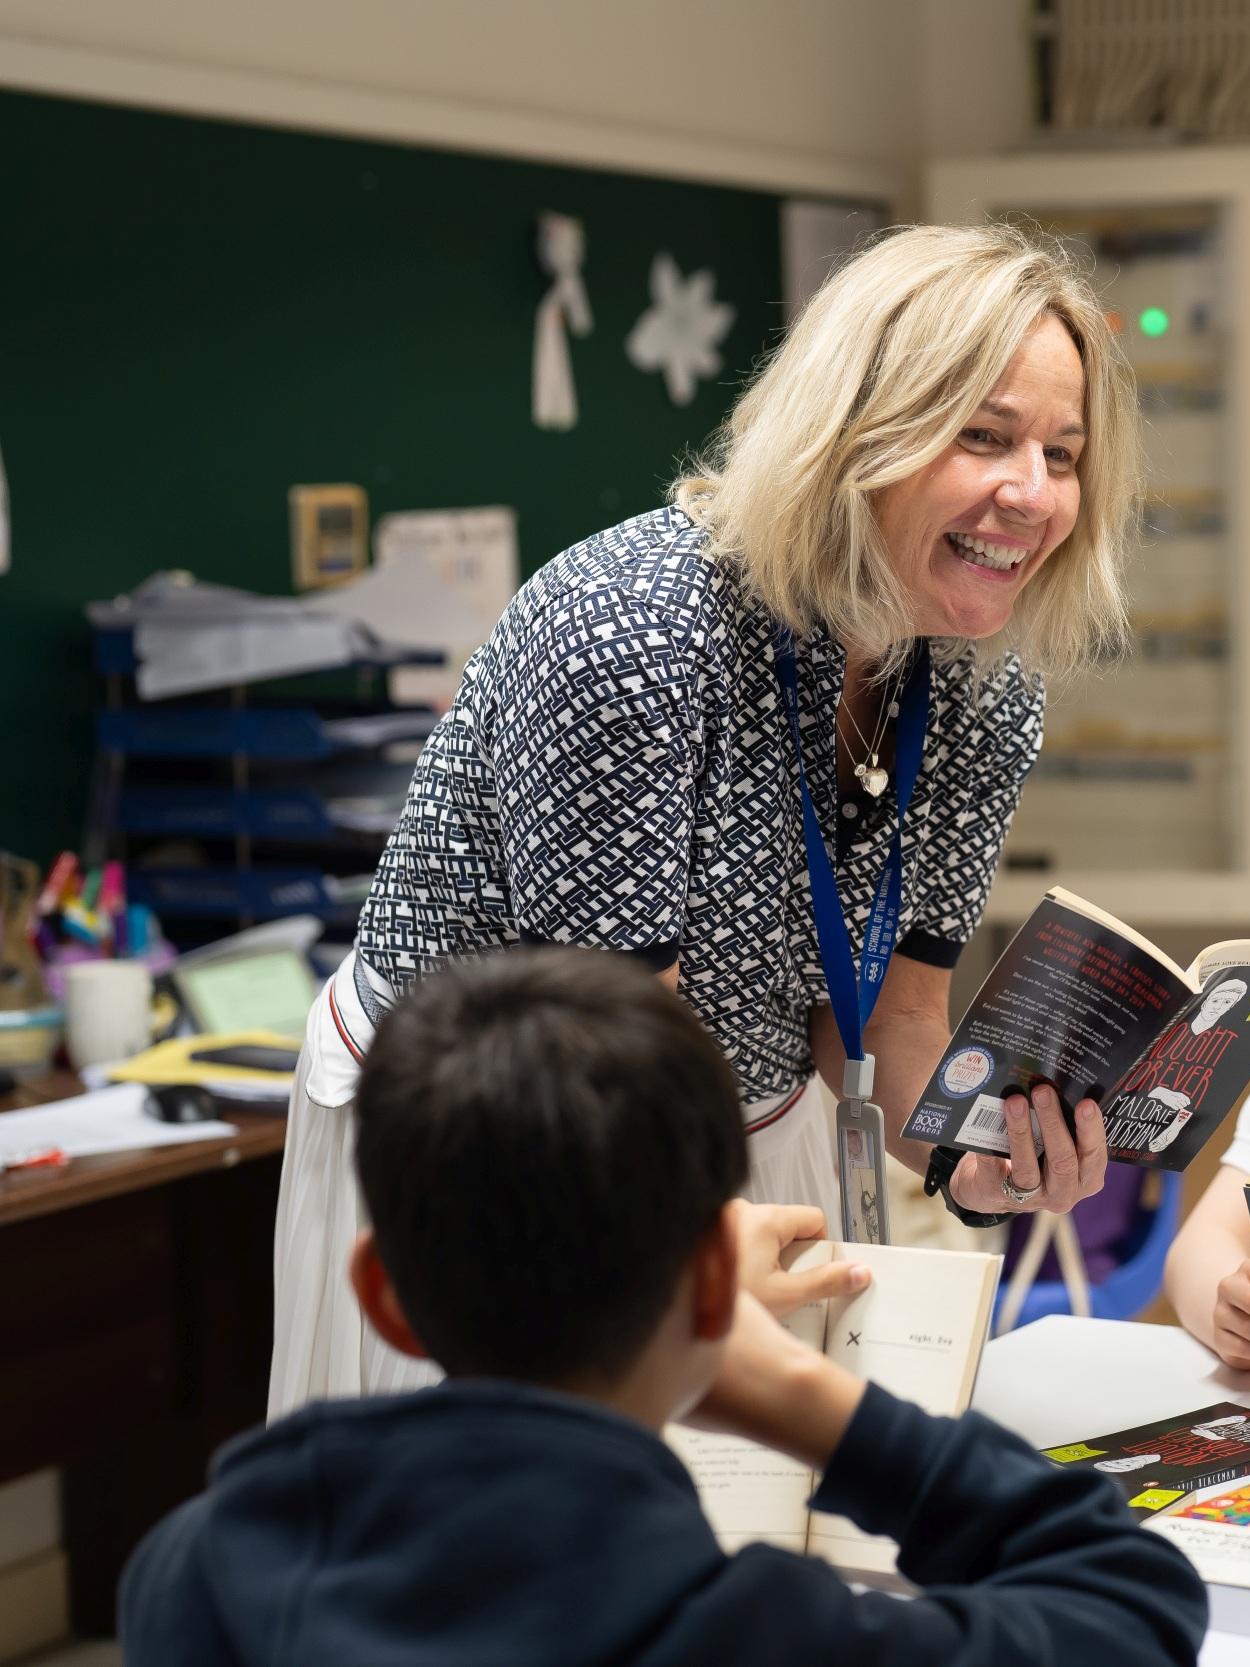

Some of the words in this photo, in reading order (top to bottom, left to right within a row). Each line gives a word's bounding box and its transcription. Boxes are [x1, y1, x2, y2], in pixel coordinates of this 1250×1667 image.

[876, 898, 886, 912] THE
[874, 914, 883, 923] OF
[868, 925, 882, 952] SCHOOL
[966, 1053, 983, 1064] WIN
[920, 1108, 948, 1120] NATIONAL
[1107, 1095, 1176, 1124] MALORIE
[914, 1114, 946, 1130] BOOK
[911, 1124, 940, 1136] tokens
[1198, 1469, 1235, 1488] BLACKMAN
